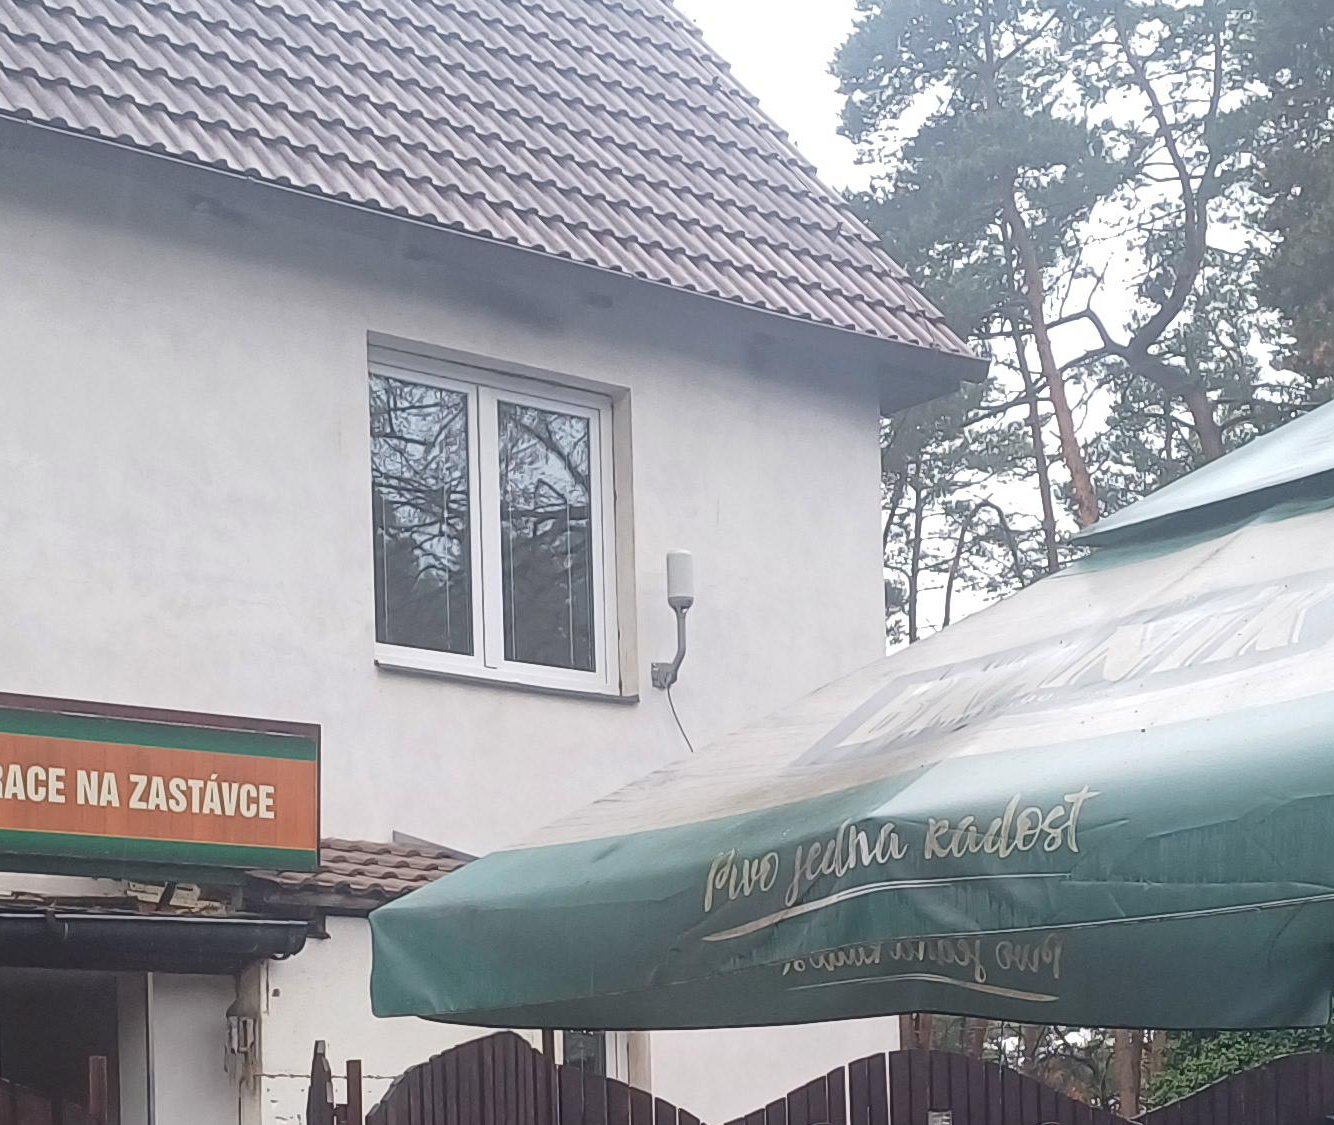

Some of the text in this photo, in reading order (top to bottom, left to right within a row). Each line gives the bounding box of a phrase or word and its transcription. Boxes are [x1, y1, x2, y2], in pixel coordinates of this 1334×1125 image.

[77, 769, 119, 807] NA
[129, 773, 275, 819] ZASTÁVCE
[784, 817, 912, 906] jedna
